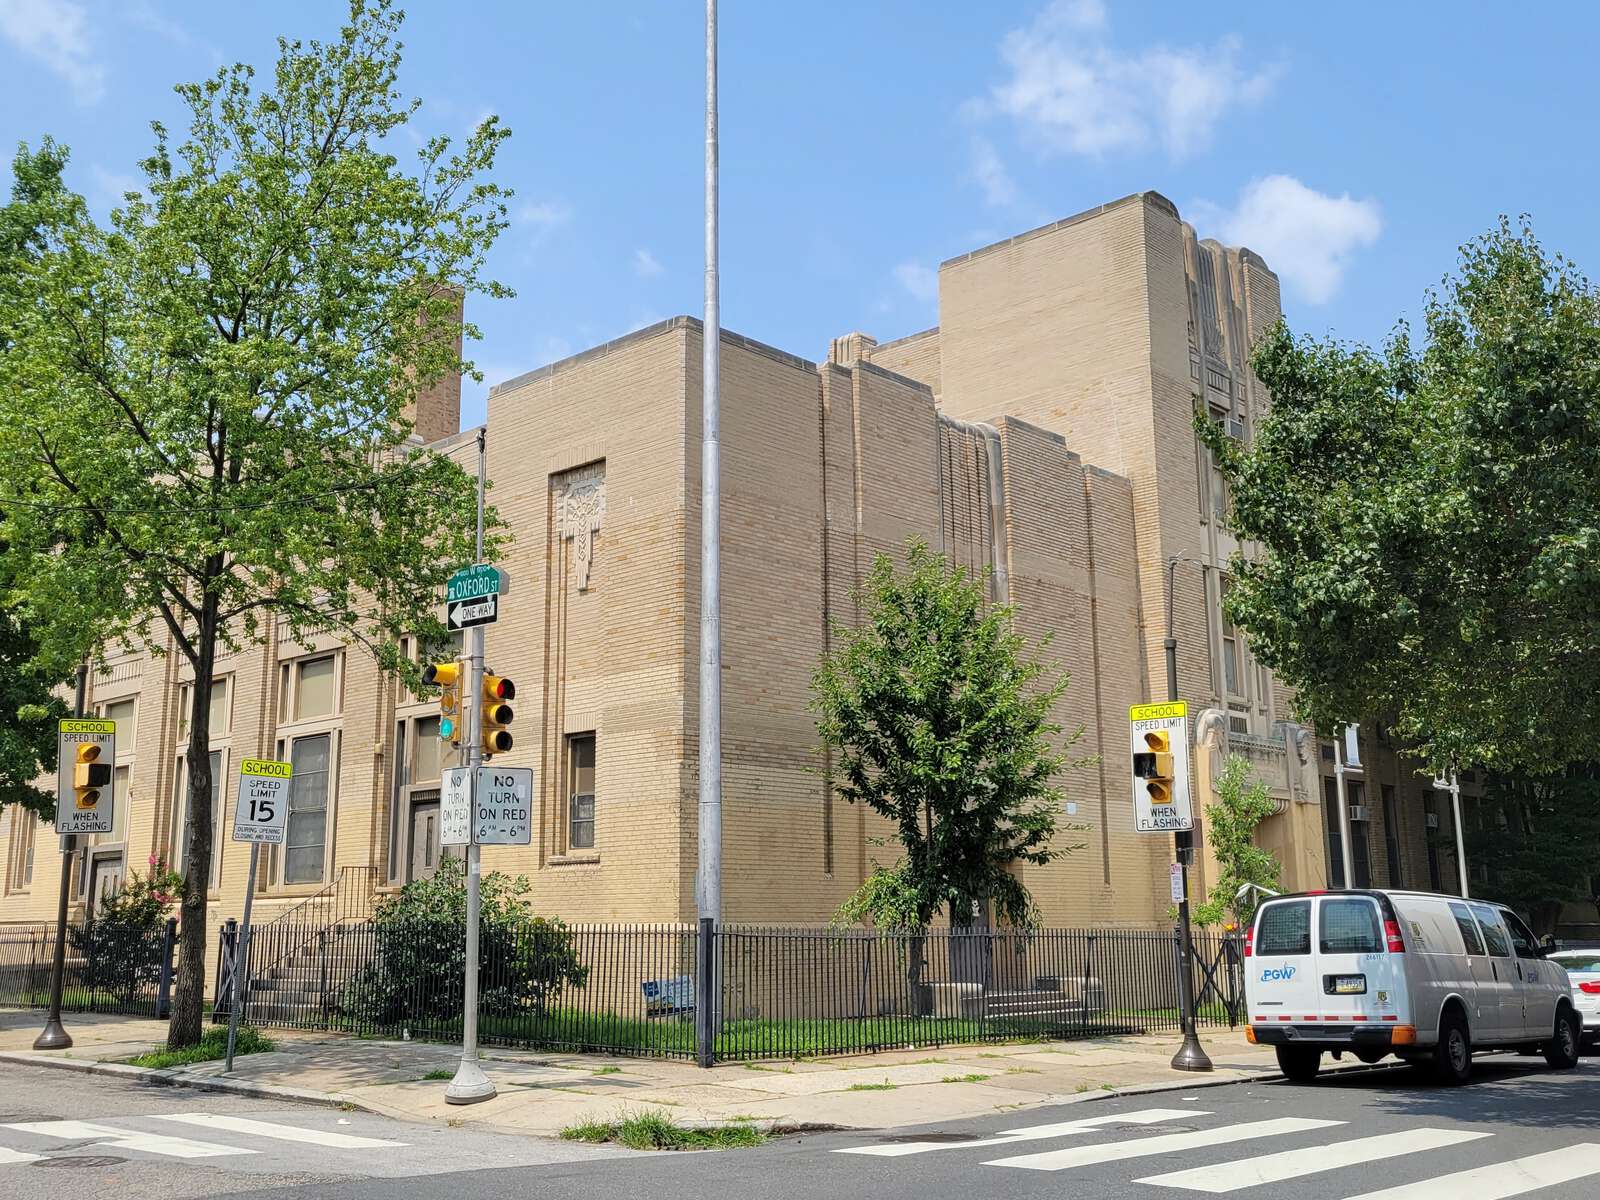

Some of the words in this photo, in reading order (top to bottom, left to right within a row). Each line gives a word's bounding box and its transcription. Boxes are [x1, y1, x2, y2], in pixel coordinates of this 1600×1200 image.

[456, 577, 490, 598] OXFORD
[491, 580, 498, 592] ST
[463, 607, 476, 619] ONE
[479, 603, 493, 616] WAY
[1138, 707, 1178, 718] SCHOOL
[67, 723, 109, 732] SCHOOL
[1135, 720, 1160, 731] SPEED
[1162, 718, 1182, 728] LIMIT
[64, 734, 89, 743] SPEED
[92, 734, 111, 743] LIMIT
[246, 762, 288, 776] SCHOOL
[249, 780, 281, 790] SPEED
[450, 776, 462, 787] NO
[494, 776, 515, 787] NO
[251, 789, 278, 799] LIMIT
[448, 792, 465, 805] TURN
[488, 792, 520, 804] TURN
[72, 812, 99, 821] WHEN
[249, 800, 275, 822] 15
[443, 809, 452, 821] ON
[454, 808, 468, 820] RED
[480, 808, 496, 820] ON
[503, 808, 527, 820] RED
[1150, 807, 1177, 818] WHEN
[61, 821, 107, 831] FLASHING
[1141, 818, 1188, 829] FLASHING
[1263, 969, 1294, 981] PGW
